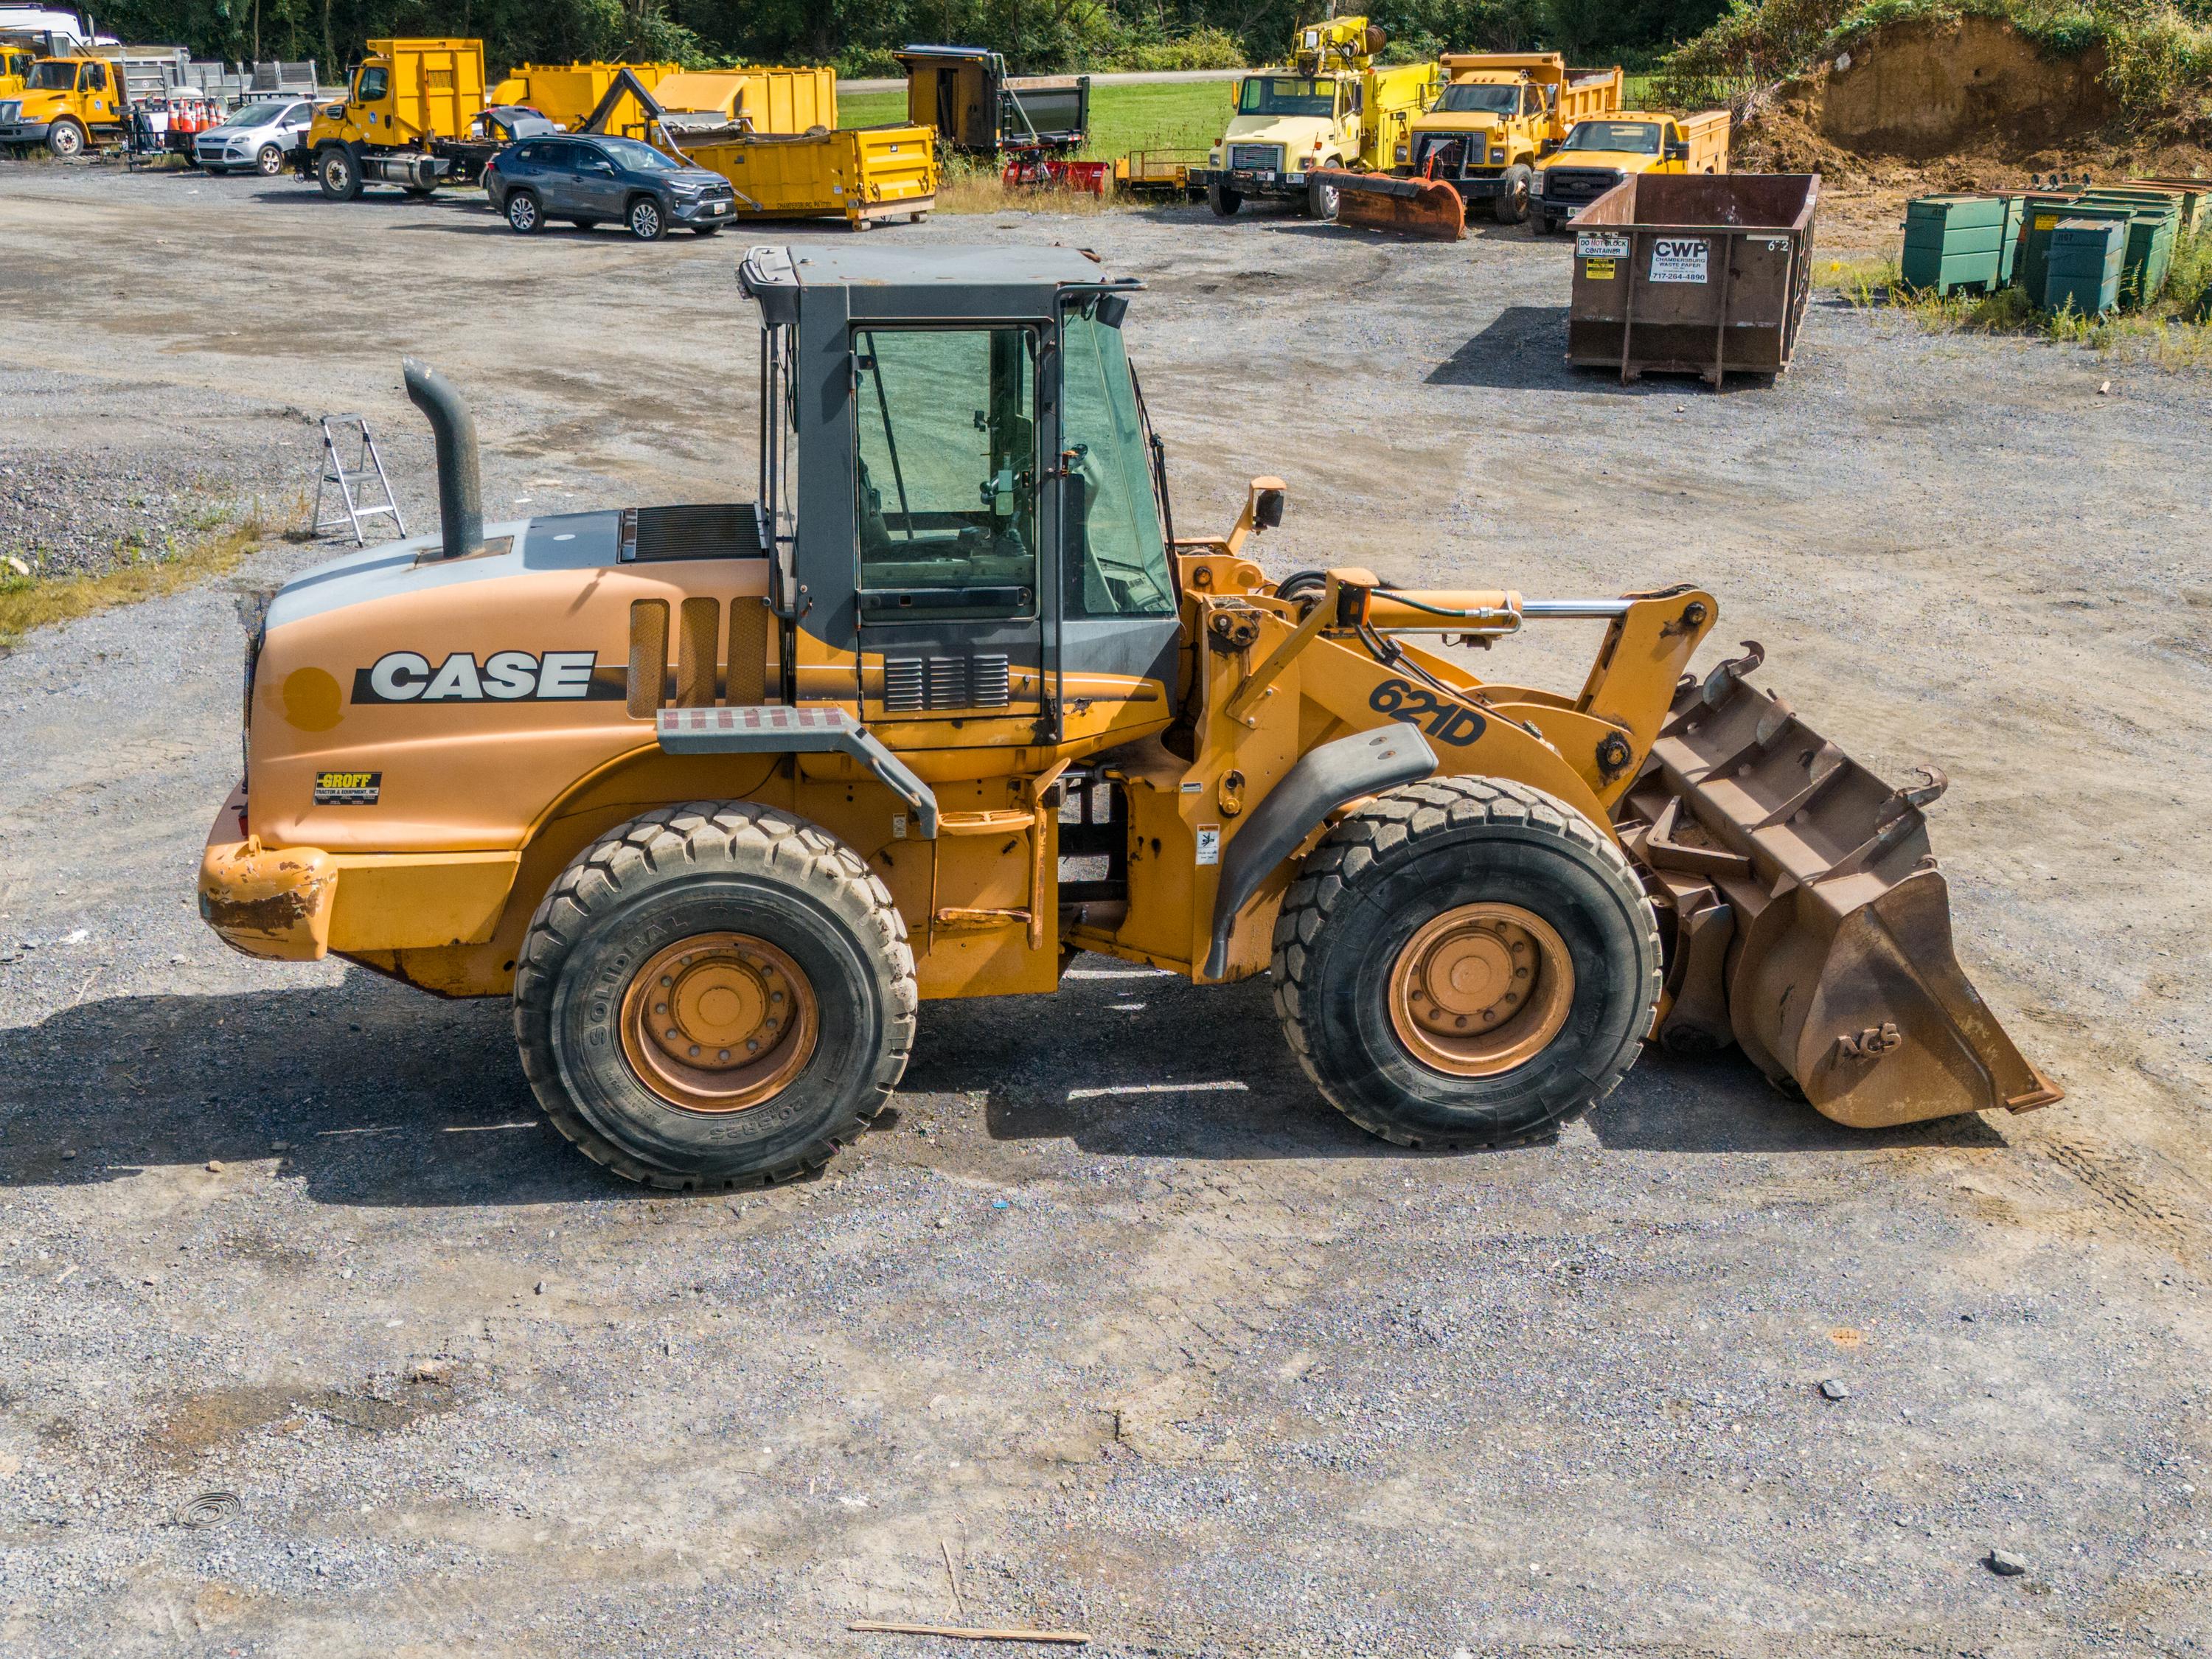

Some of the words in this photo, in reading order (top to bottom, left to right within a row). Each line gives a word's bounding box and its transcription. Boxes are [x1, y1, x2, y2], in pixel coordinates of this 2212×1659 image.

[1655, 242, 1708, 258] CWP
[1652, 273, 1705, 281] 717-264-4890
[371, 652, 596, 700] CASE
[1368, 678, 1487, 747] 621D
[321, 773, 372, 787] GROFF
